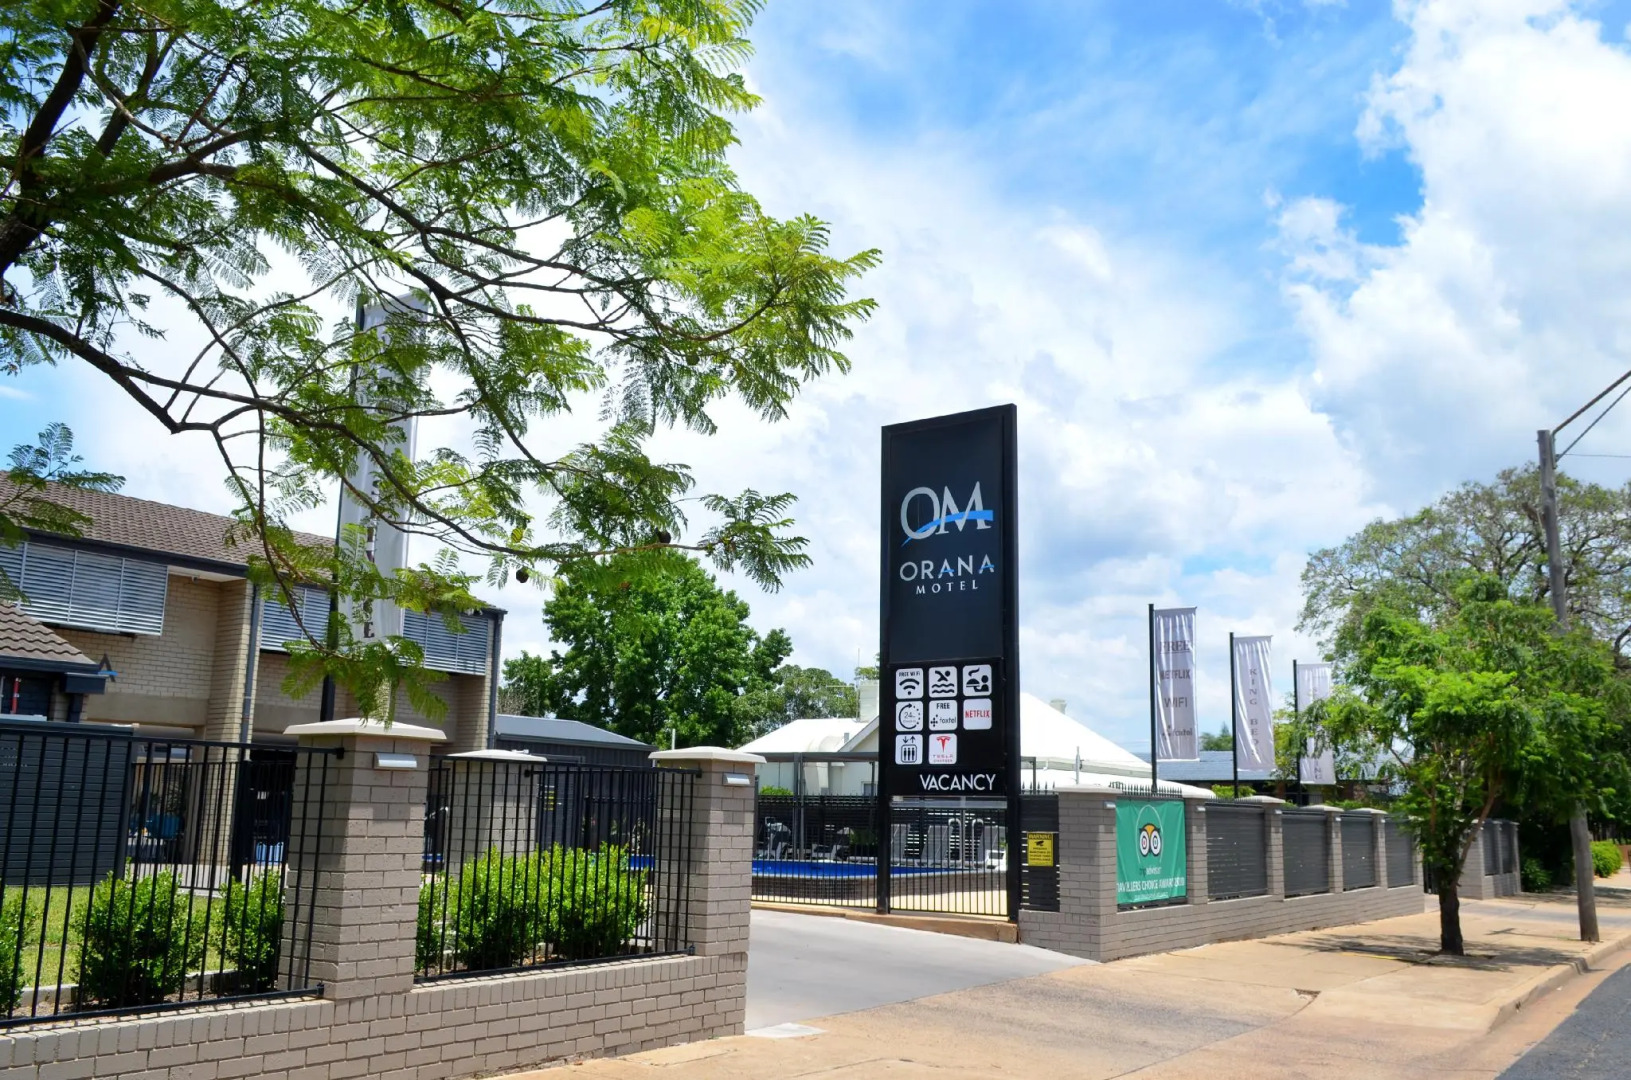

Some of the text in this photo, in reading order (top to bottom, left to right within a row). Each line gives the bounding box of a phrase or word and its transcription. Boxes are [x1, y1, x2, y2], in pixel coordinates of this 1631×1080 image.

[901, 481, 991, 540] OM
[900, 553, 994, 581] ORANA
[916, 579, 978, 594] MOTEL
[936, 702, 950, 710] FREE
[965, 709, 990, 718] NETFLIX
[920, 774, 996, 790] VACANCY
